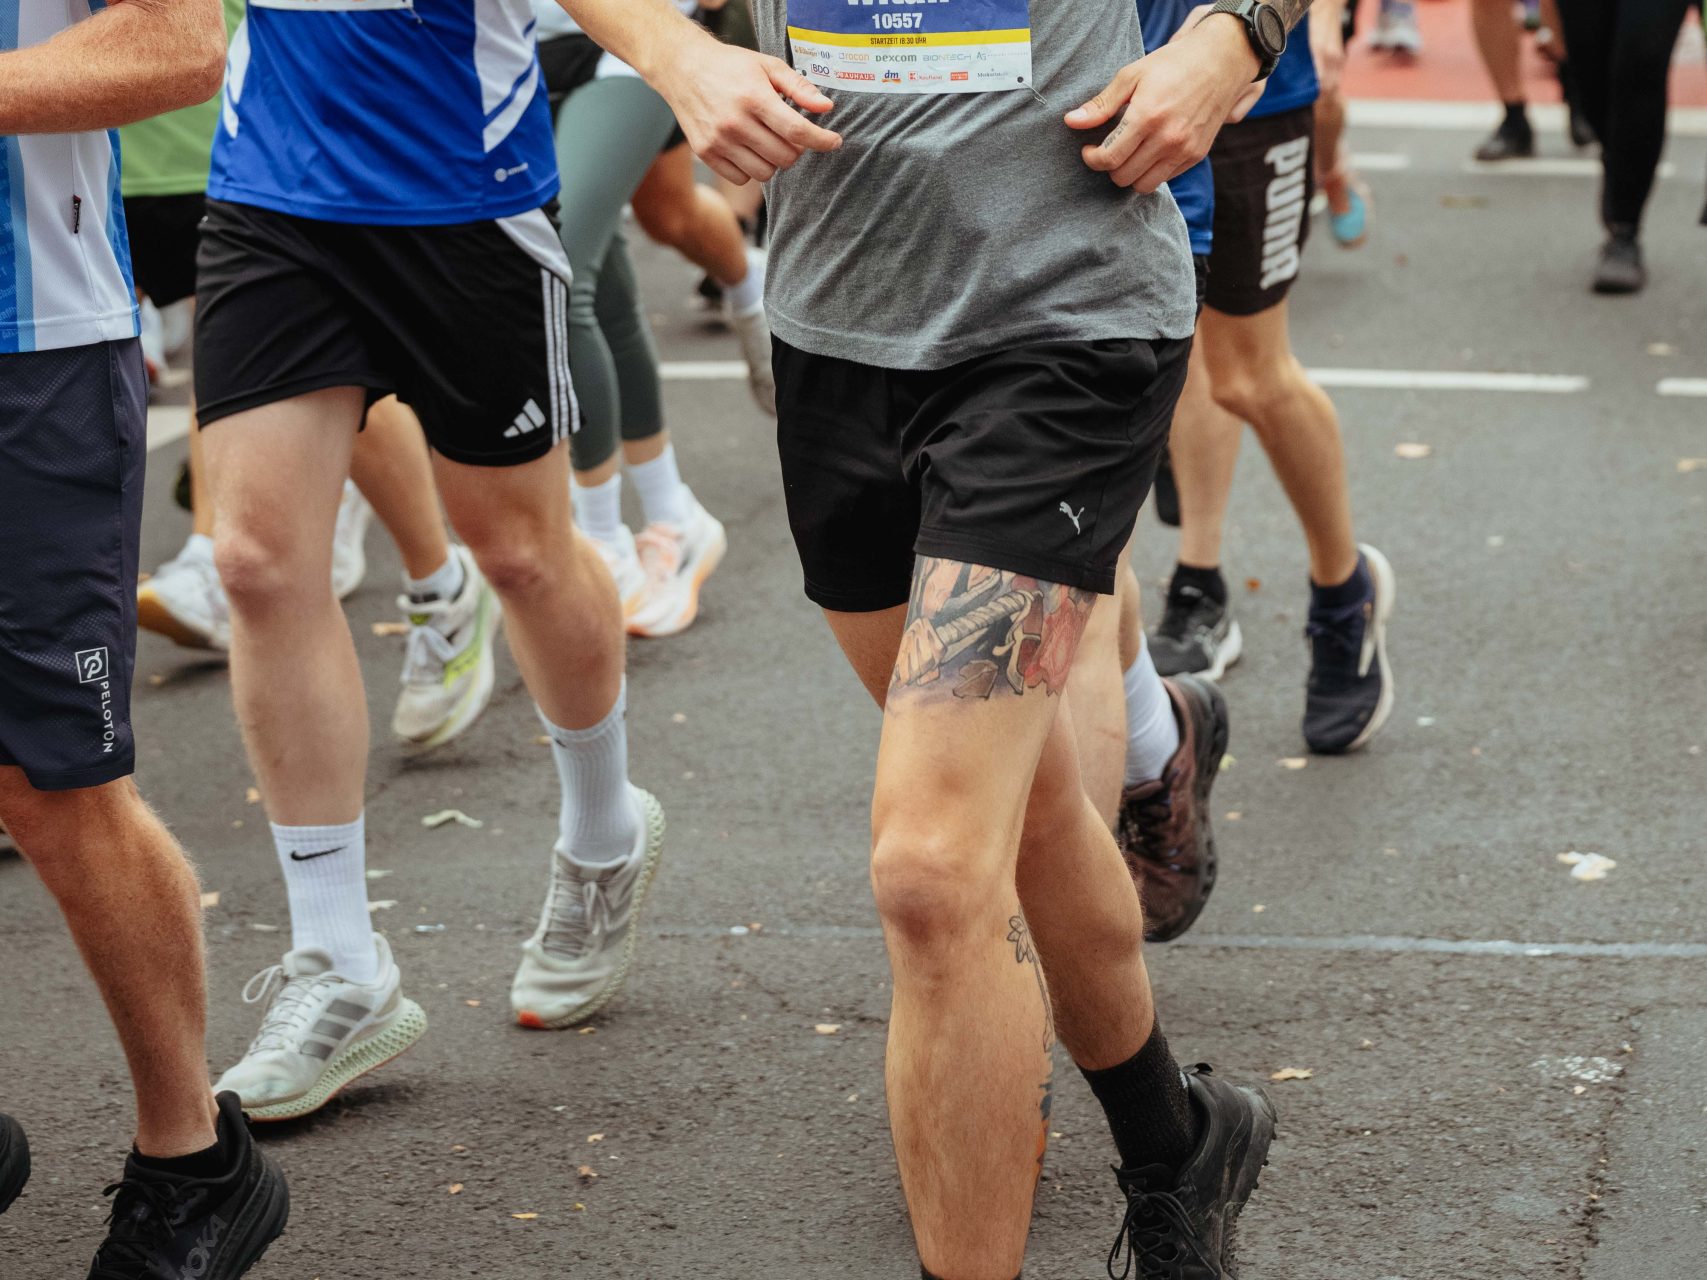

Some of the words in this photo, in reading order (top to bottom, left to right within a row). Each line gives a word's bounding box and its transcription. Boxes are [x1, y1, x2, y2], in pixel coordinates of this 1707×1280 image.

[872, 12, 923, 30] 10557
[870, 37, 898, 45] STARTZEIT
[915, 37, 927, 45] UHR
[811, 63, 830, 75] BDO
[884, 70, 899, 79] dm
[1260, 135, 1309, 290] PUMA
[100, 680, 115, 753] PELOTON
